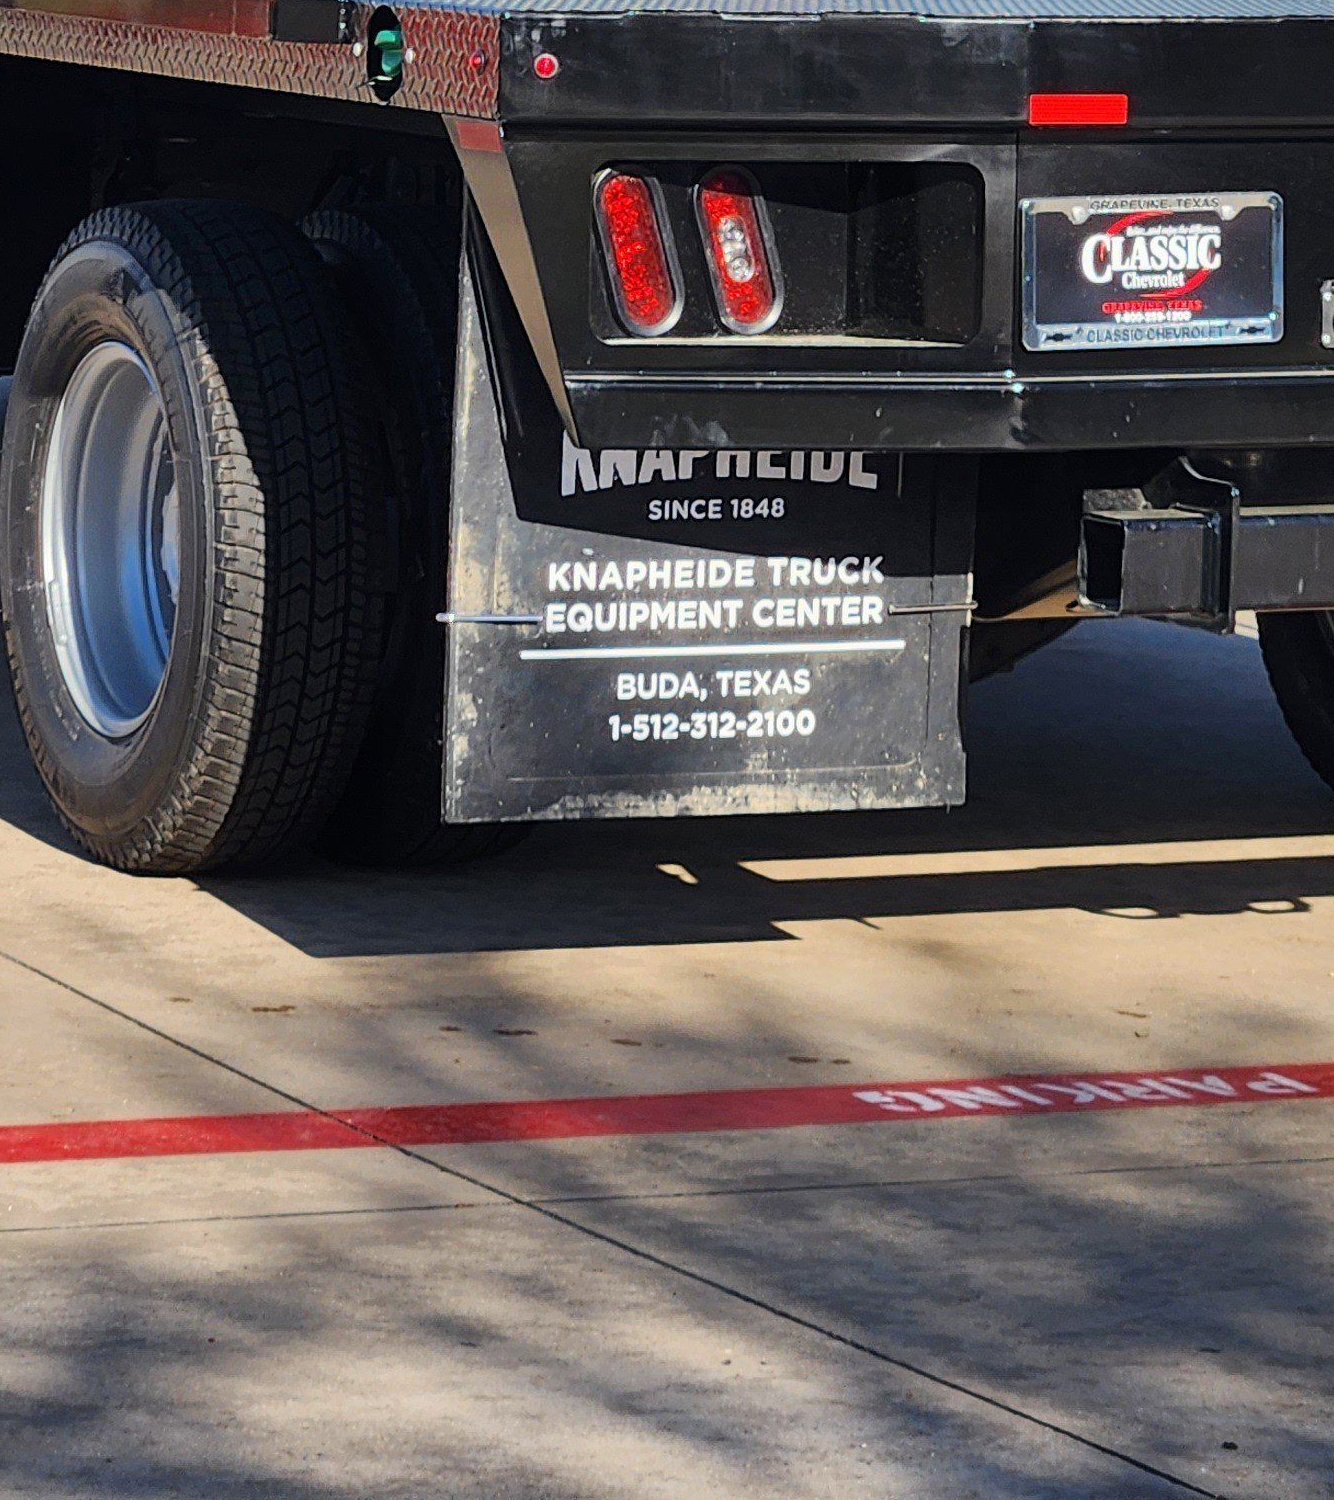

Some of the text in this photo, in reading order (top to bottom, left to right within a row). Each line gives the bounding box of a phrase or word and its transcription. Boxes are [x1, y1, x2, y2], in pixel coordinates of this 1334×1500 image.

[1176, 197, 1220, 208] TEXAS
[1081, 233, 1222, 284] CLASSIC
[1122, 270, 1186, 289] Chevrolet
[1087, 325, 1224, 343] CLASSIC CHEVROLET
[648, 498, 785, 520] SINCE 1848
[548, 556, 885, 592] KNAPHEIDE TRUCK
[545, 595, 884, 633] EQUIPMENT CENTER
[617, 668, 811, 702] BUDA, TEXAS
[608, 709, 816, 741] 1-512-312-2100
[852, 1072, 1319, 1113] PARKING
